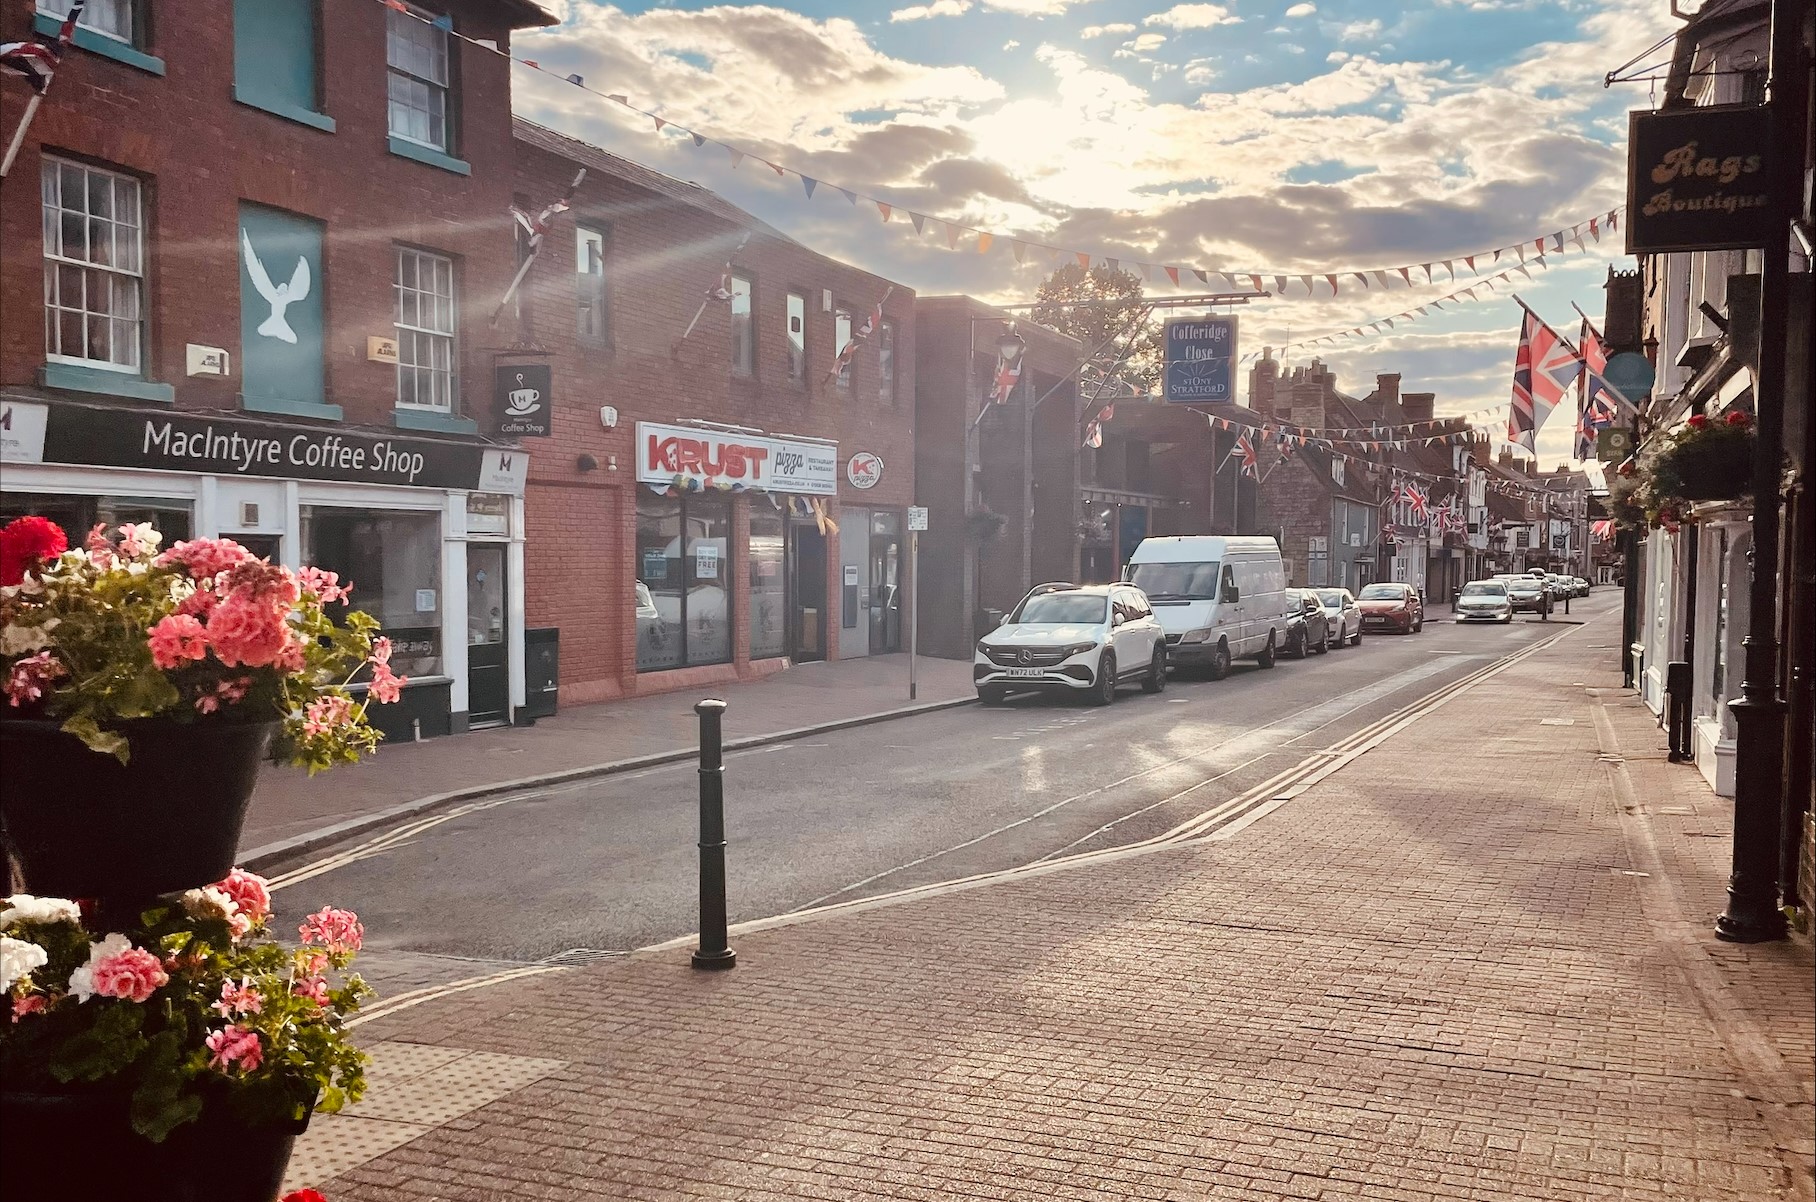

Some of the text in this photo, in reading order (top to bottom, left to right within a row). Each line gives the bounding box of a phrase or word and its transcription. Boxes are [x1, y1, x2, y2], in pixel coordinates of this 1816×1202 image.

[1651, 141, 1761, 184] Rags
[1642, 188, 1769, 216] Boutique
[1172, 324, 1227, 342] Cofferidge
[1185, 345, 1213, 360] Close
[501, 423, 544, 434] Coffee Shop
[142, 420, 424, 482] MacIntyre Coffee Shop
[499, 452, 512, 472] M
[648, 435, 768, 479] KRUST
[774, 446, 804, 475] pizza
